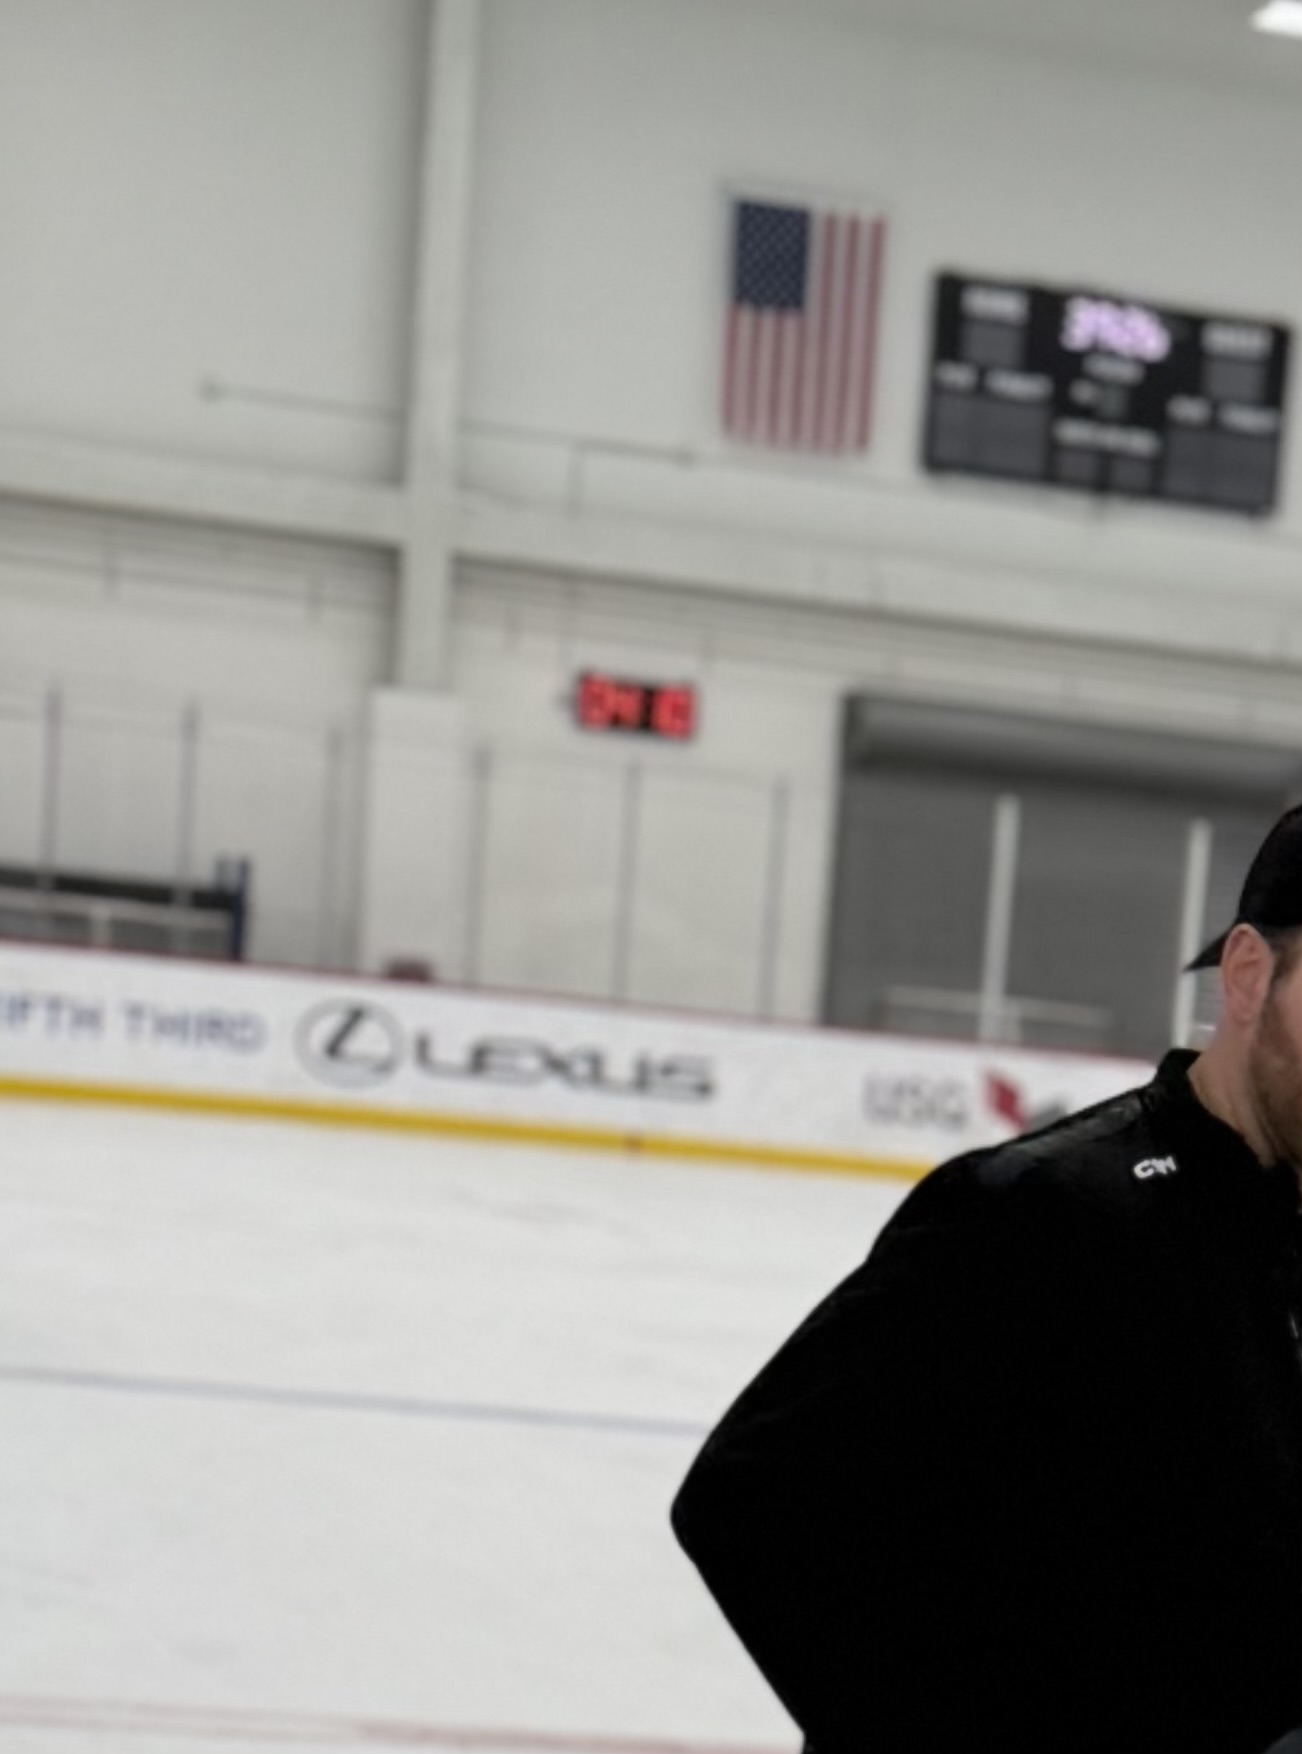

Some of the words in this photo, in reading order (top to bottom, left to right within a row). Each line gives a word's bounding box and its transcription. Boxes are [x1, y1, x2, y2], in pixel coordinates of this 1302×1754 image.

[0, 992, 104, 1040] IFTH
[122, 1000, 268, 1056] THIRD
[416, 1032, 715, 1104] LEXUS
[862, 1071, 970, 1133] USG
